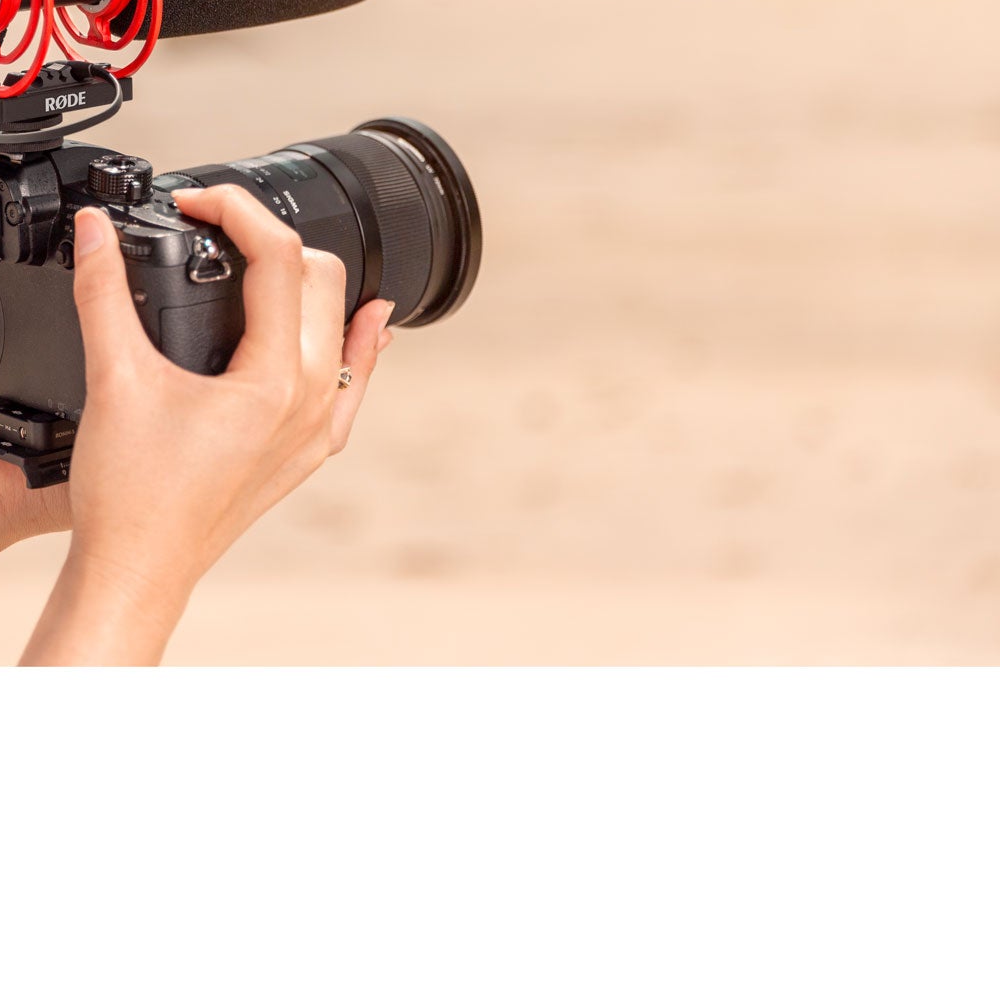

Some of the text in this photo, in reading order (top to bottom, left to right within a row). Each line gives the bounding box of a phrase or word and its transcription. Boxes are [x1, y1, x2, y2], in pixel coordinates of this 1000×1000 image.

[45, 91, 86, 112] RØDE
[272, 196, 281, 205] 20
[283, 190, 299, 214] SIGMA
